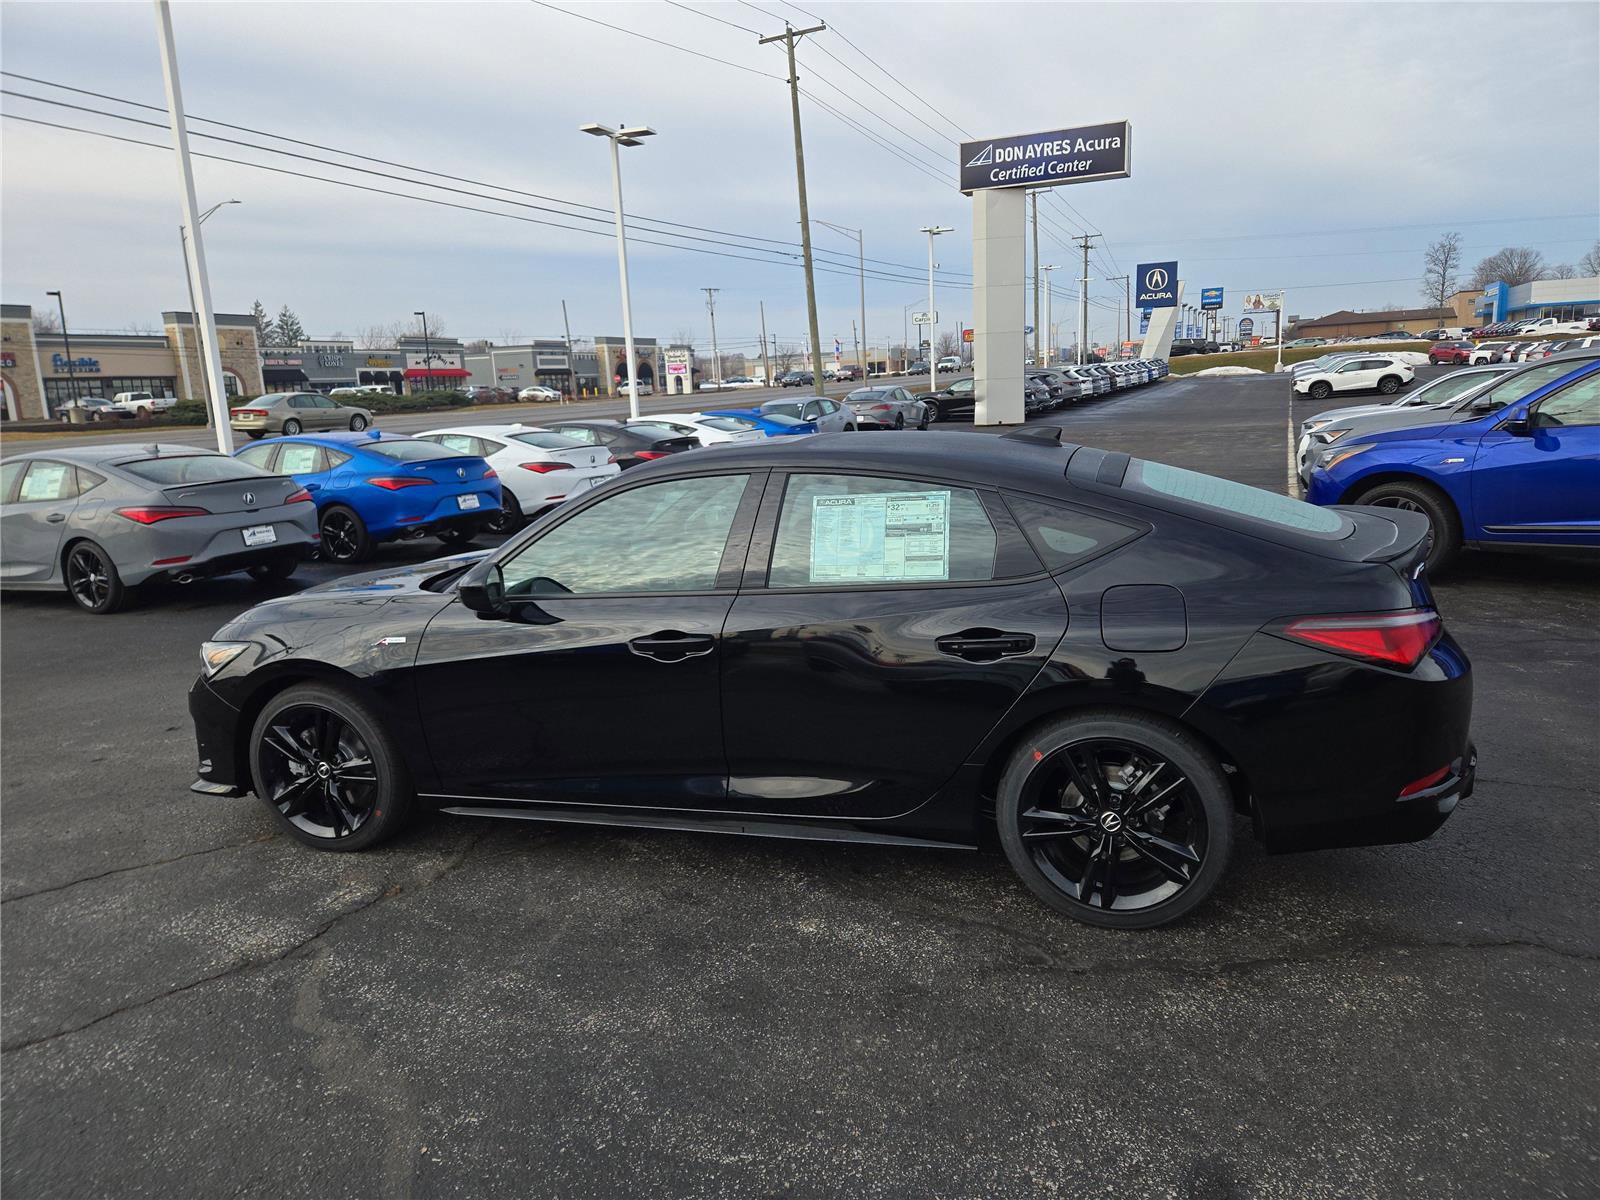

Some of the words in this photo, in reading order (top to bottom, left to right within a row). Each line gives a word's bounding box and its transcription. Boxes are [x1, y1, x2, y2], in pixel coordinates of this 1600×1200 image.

[995, 146, 1023, 163] DON
[1026, 139, 1071, 158] AYRES
[1074, 136, 1121, 153] Acura
[990, 164, 1045, 182] Certified
[1047, 159, 1093, 175] Center
[1140, 291, 1173, 300] ACURA
